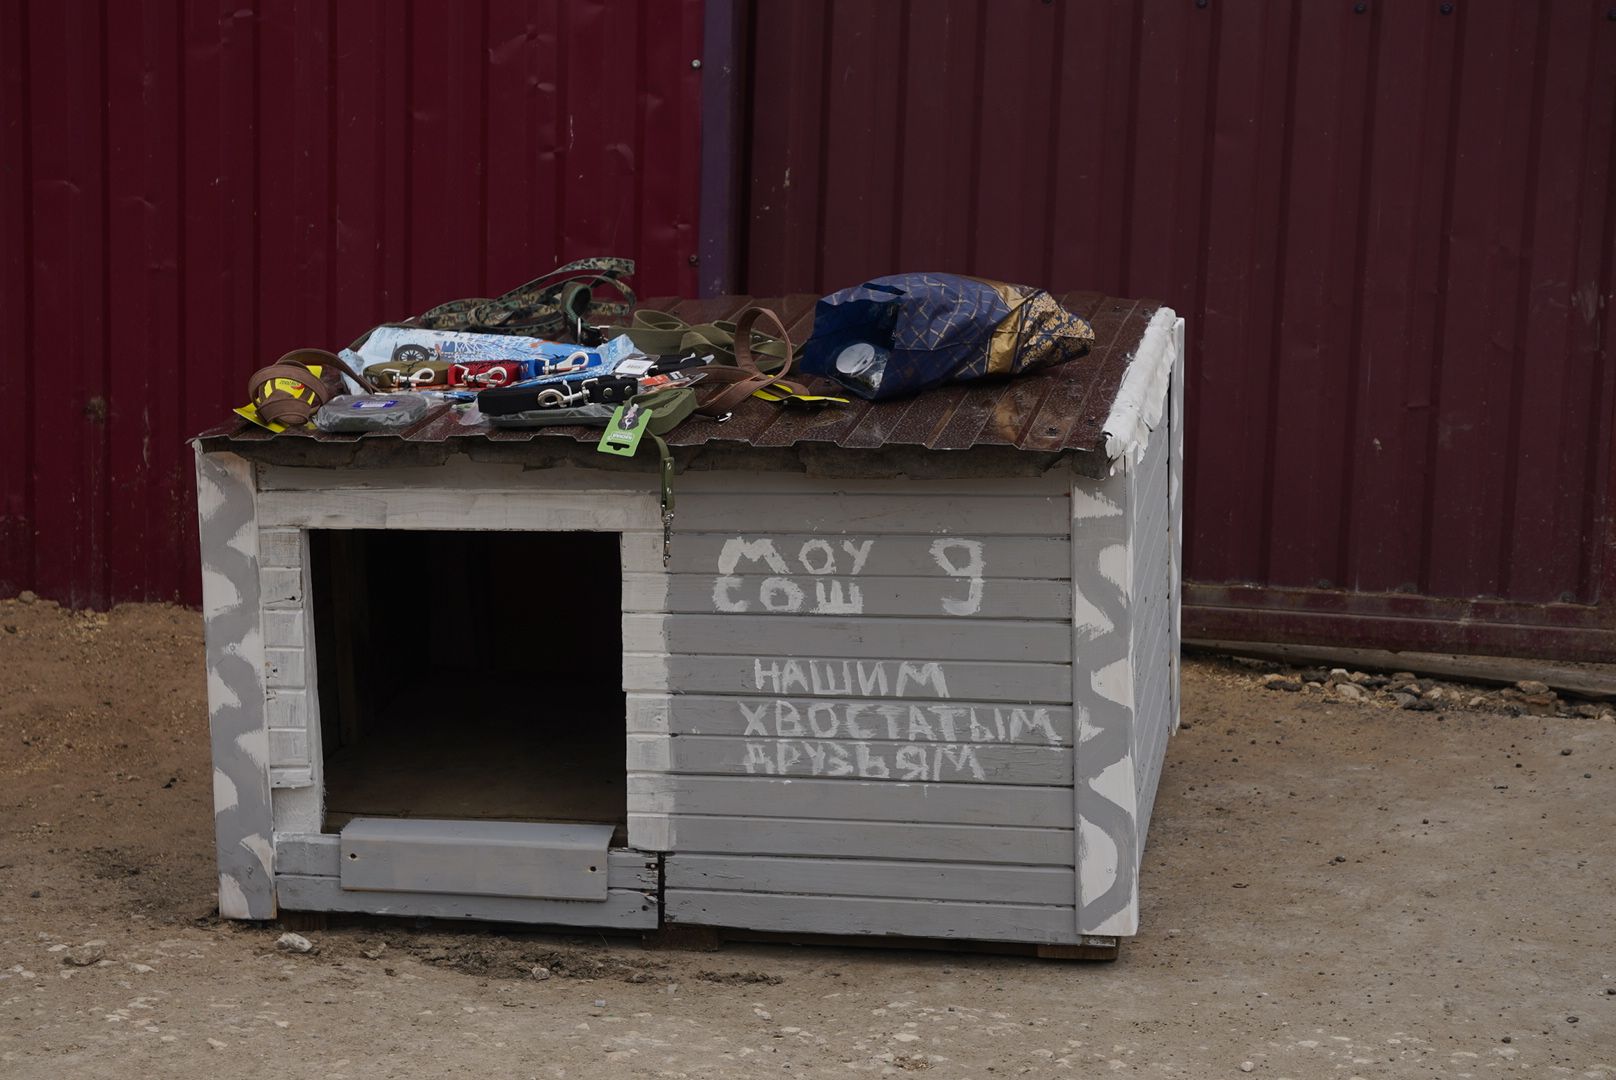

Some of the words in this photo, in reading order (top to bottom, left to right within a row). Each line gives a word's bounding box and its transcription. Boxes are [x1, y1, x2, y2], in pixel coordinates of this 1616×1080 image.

[718, 536, 874, 575] МОУ
[712, 576, 863, 614] СОШ
[928, 537, 986, 616] 9
[754, 658, 950, 698] НАШИМ
[738, 701, 1063, 744] ХВОСТАТЫМ
[742, 742, 985, 781] ДРУЗЬЯМ
